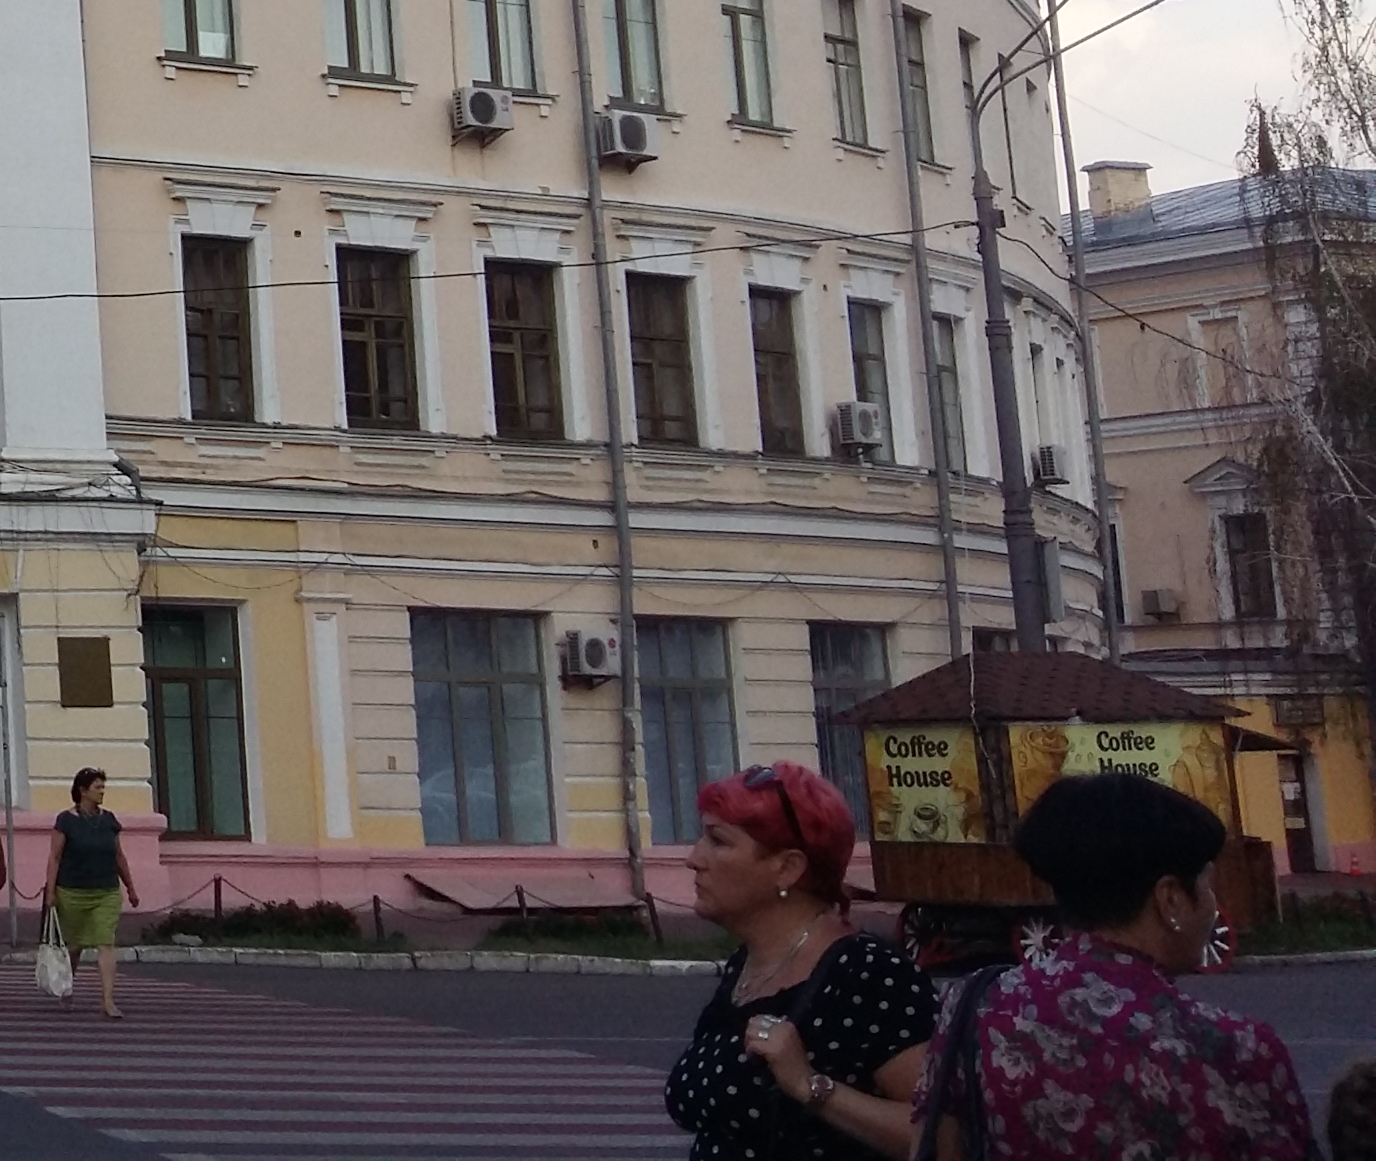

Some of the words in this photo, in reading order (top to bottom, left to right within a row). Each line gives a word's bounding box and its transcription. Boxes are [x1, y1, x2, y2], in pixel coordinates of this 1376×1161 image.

[884, 734, 949, 758] Coffee
[1096, 729, 1156, 752] Coffee
[885, 764, 953, 788] House
[1098, 757, 1160, 777] House
